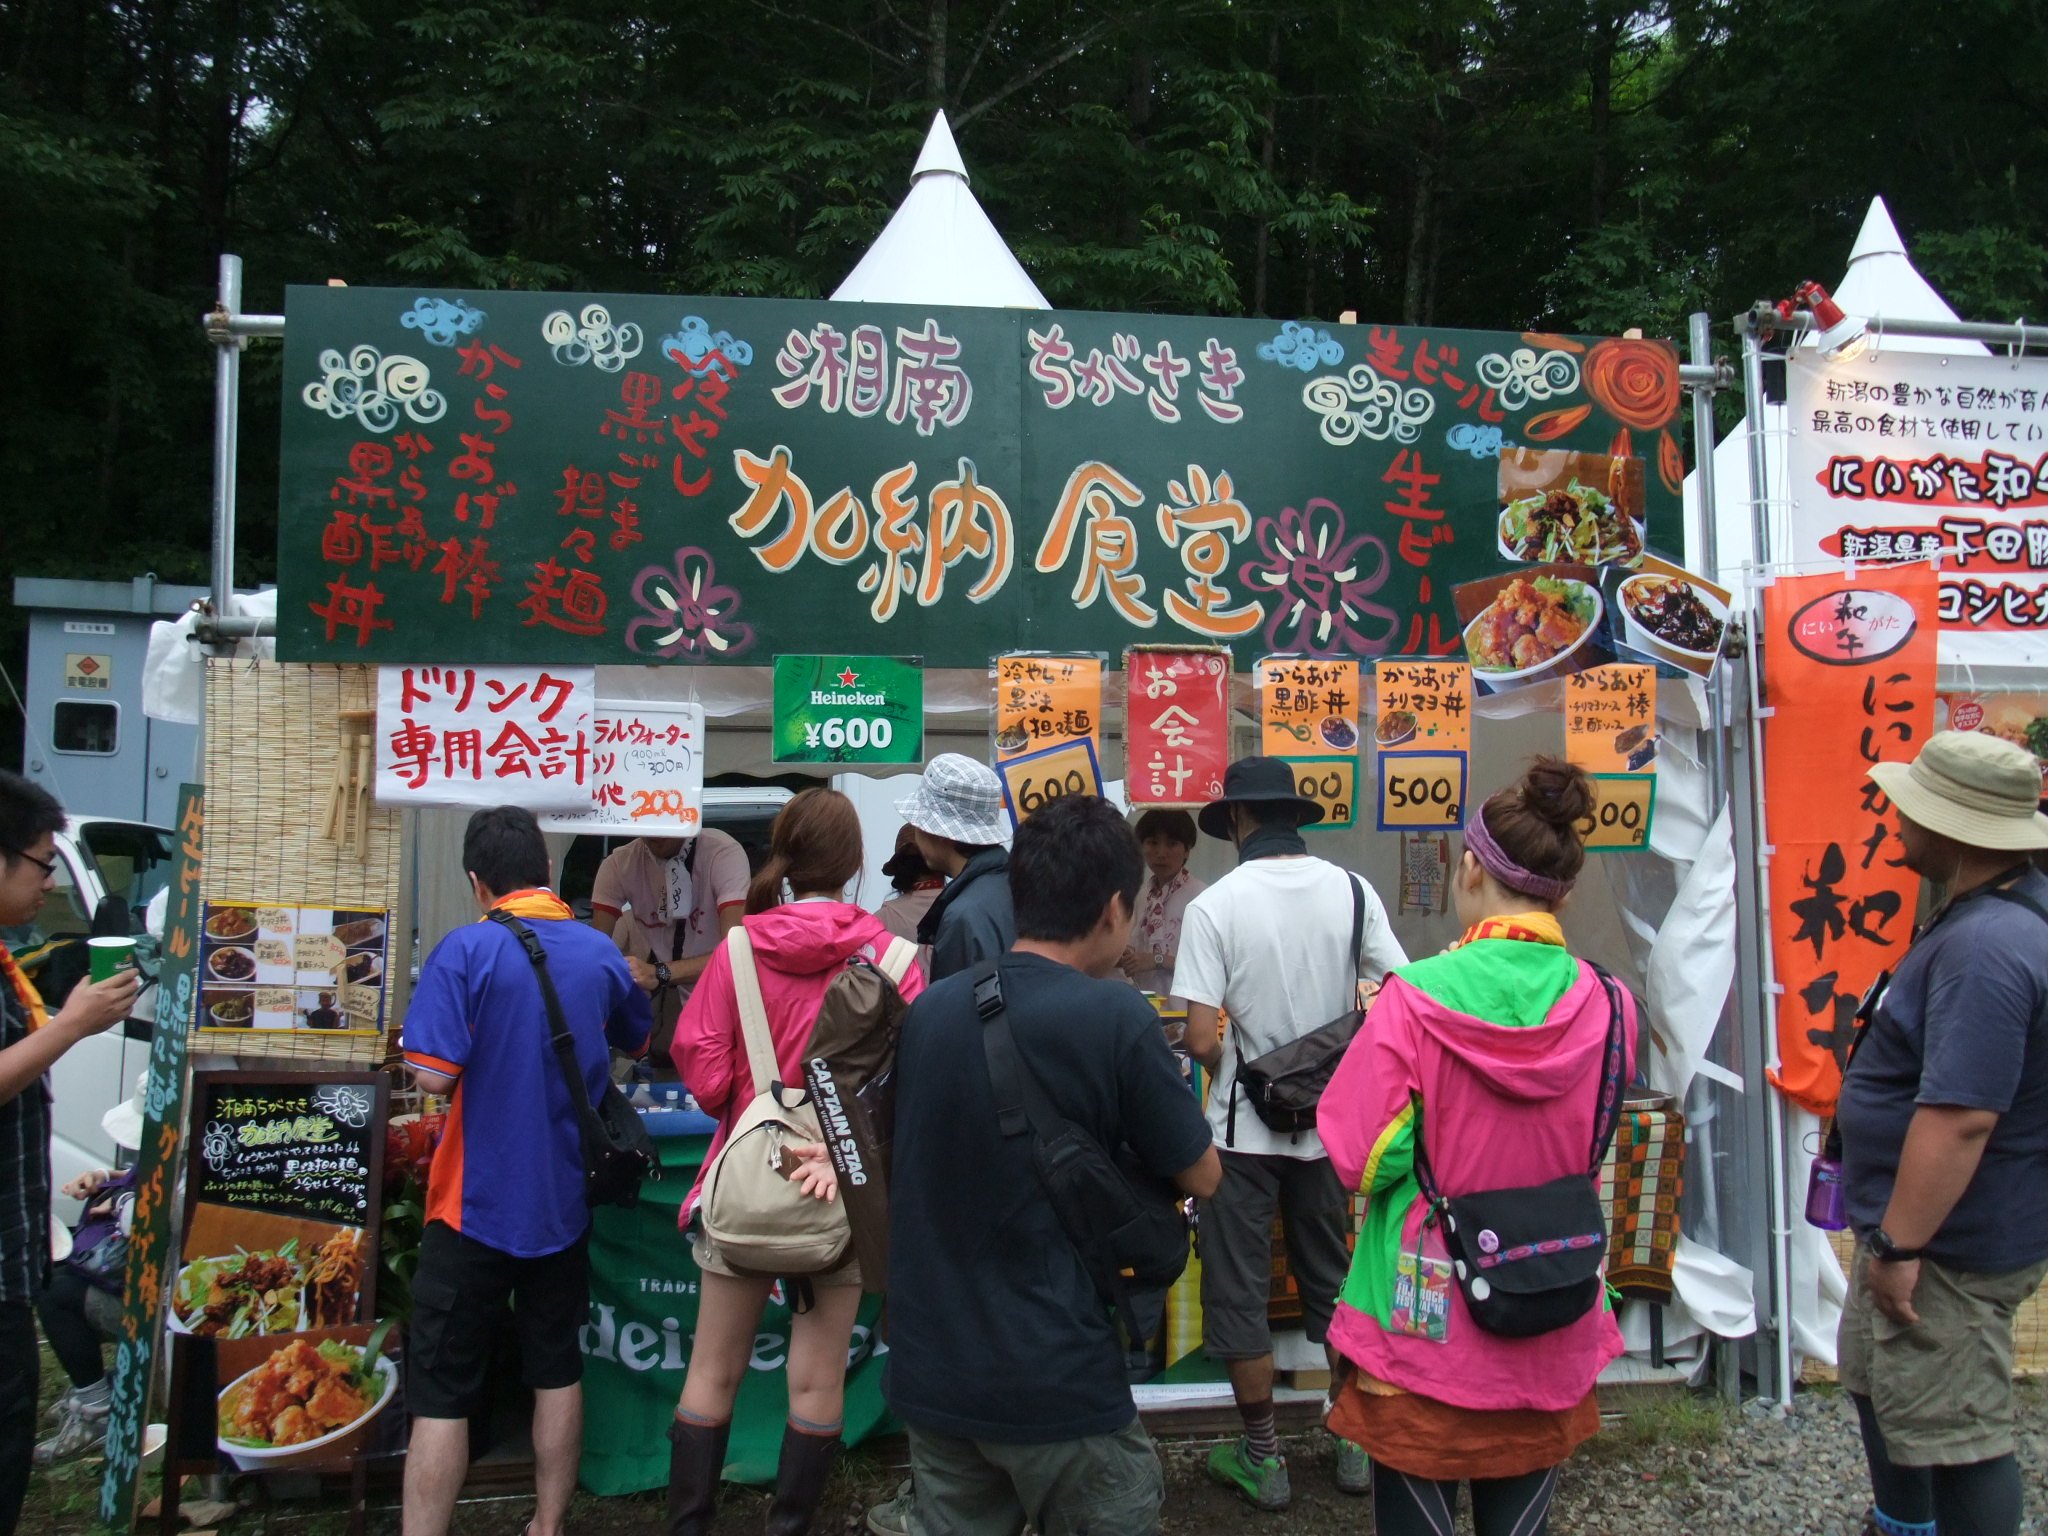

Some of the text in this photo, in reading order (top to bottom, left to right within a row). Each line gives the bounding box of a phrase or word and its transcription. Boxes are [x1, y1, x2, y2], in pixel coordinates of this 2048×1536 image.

[771, 318, 1245, 437] 湘南 ちがさき
[1366, 326, 1506, 422] 生ビール
[308, 441, 398, 648] 黒酢丼
[1380, 448, 1460, 656] 生ビール
[1268, 664, 1348, 688] からあげ
[1382, 666, 1465, 691] からあげ
[1571, 668, 1651, 691] からあげ
[401, 667, 574, 723] ドリンク
[811, 690, 885, 705] Heineken
[1004, 687, 1055, 713] 黒ごま
[1269, 687, 1350, 716] 黒酢丼
[1382, 691, 1467, 718] チリマヨ丼
[1625, 690, 1652, 719] 棒
[804, 717, 893, 749] ¥600
[1146, 664, 1200, 798] お会計
[388, 719, 591, 790] 専用会計
[807, 1074, 824, 1109] FREEDOM
[820, 1110, 837, 1143] VENTURE
[810, 1057, 868, 1186] CAPTAIN STAG
[640, 1278, 697, 1294] TRADE
